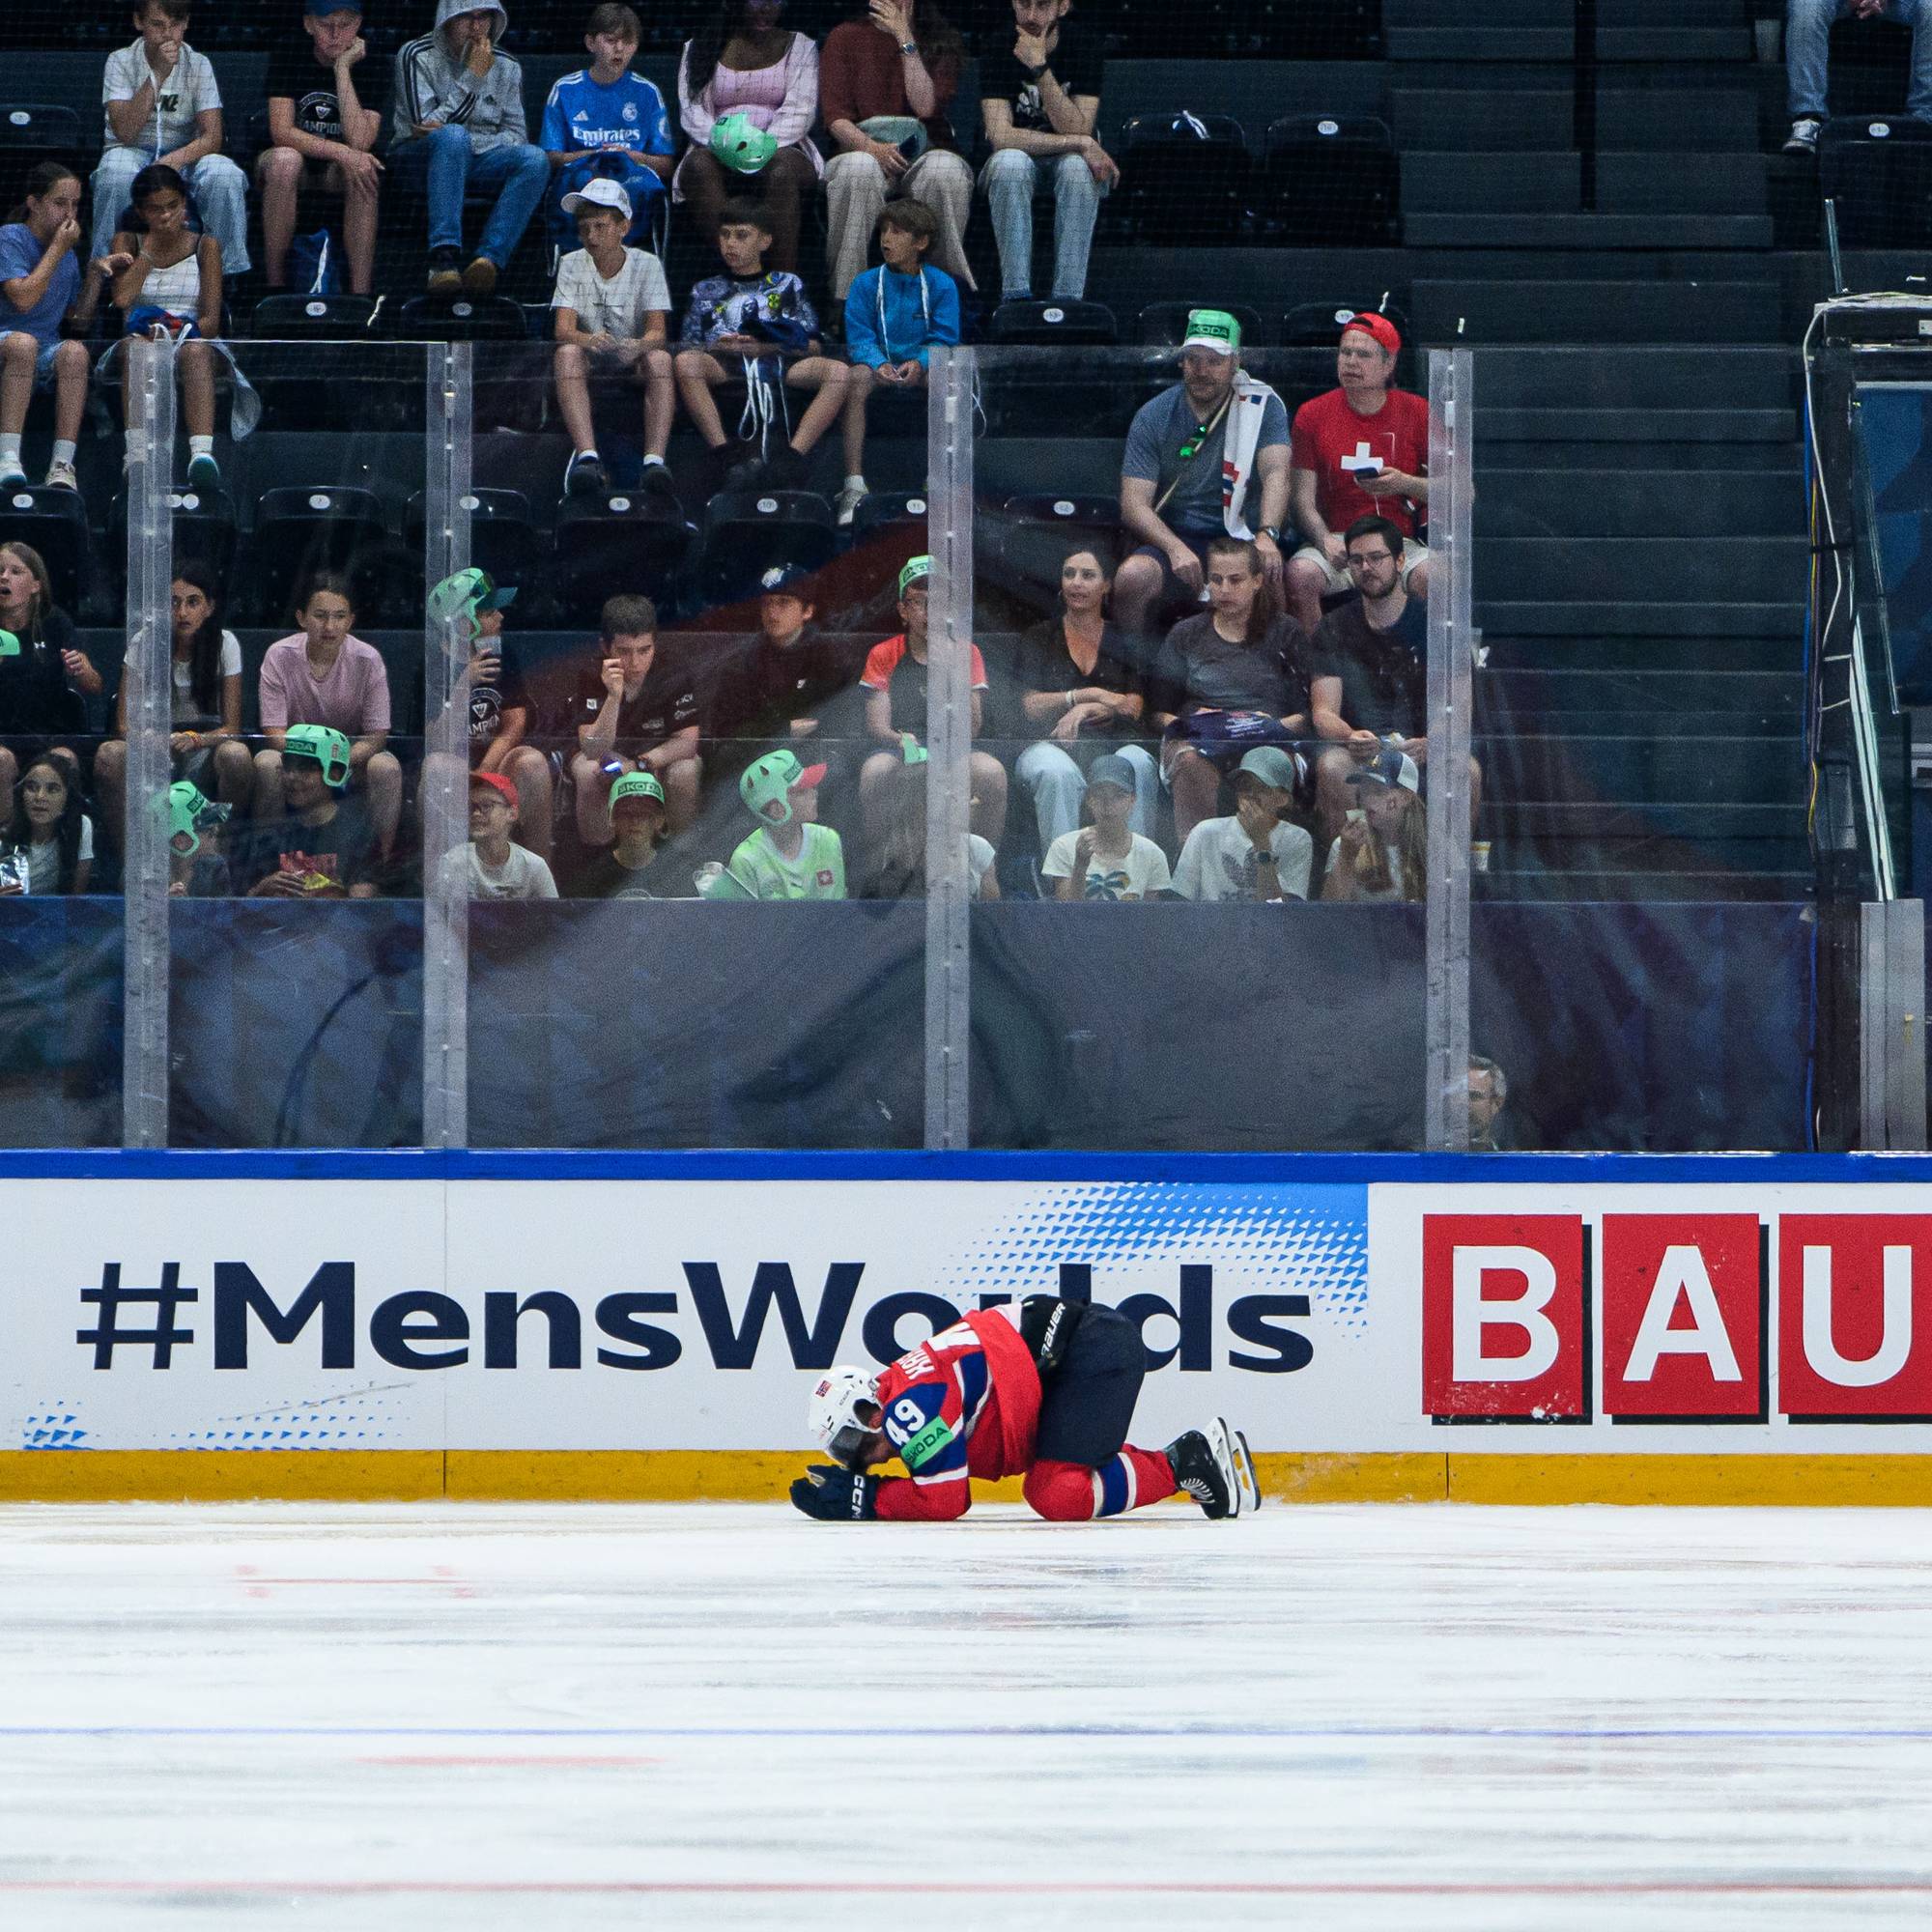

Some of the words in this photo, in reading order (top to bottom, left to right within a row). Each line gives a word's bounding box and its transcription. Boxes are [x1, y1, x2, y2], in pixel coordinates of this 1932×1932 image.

[573, 126, 640, 142] Emirates
[1451, 1244, 1912, 1387] BAU
[885, 1398, 926, 1447] 49
